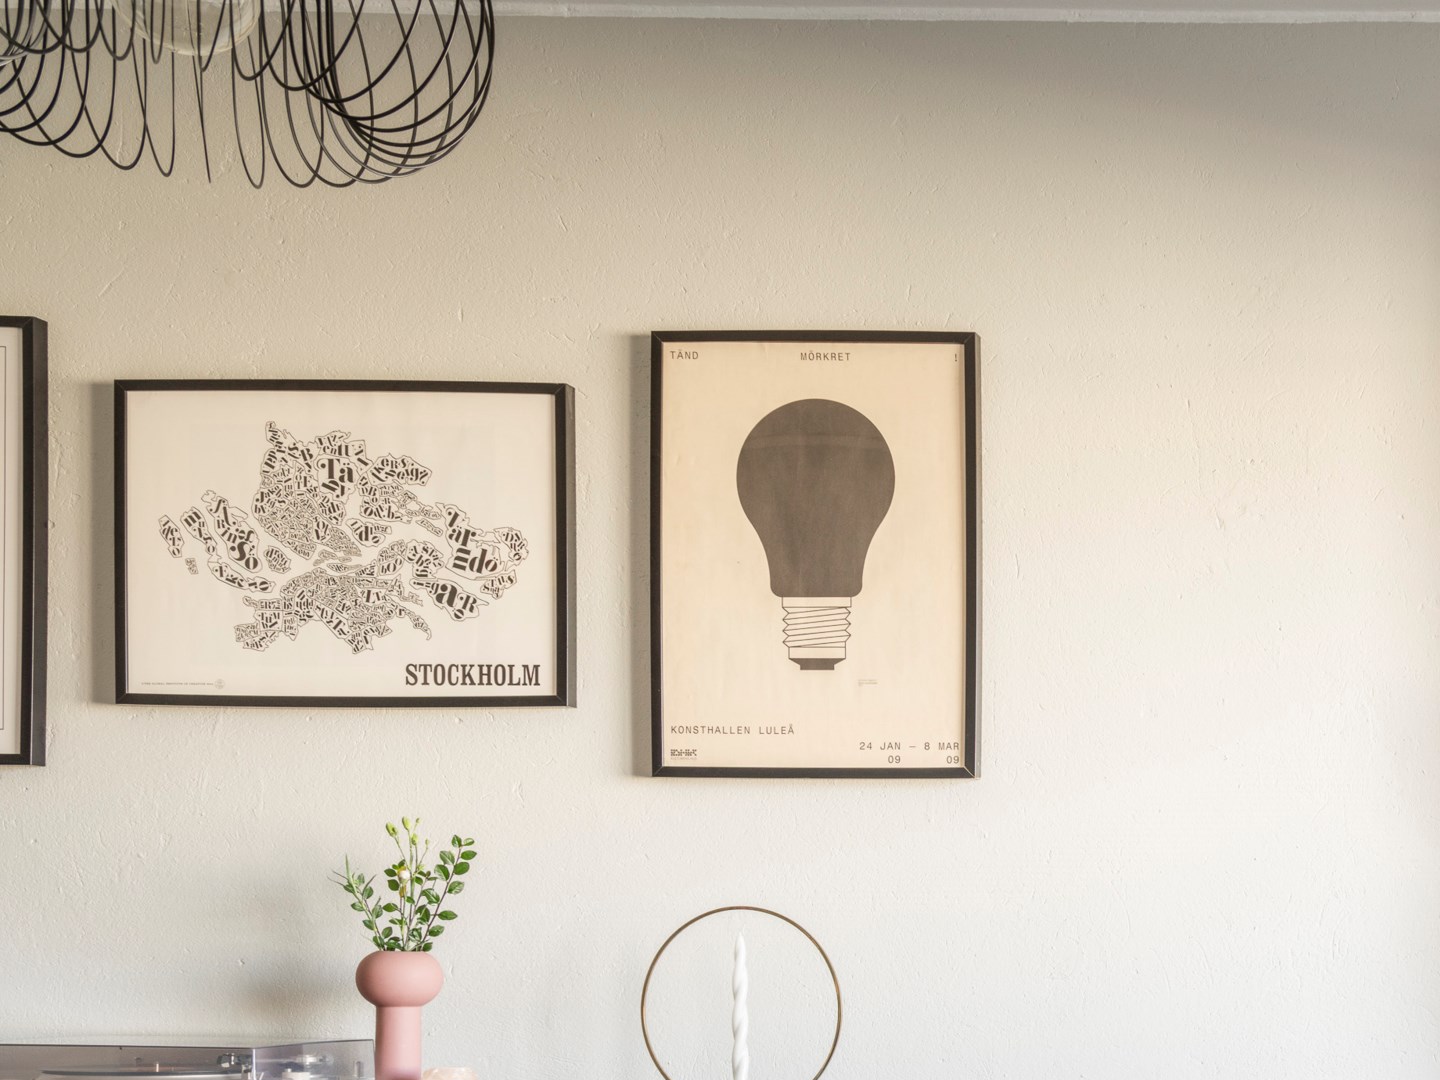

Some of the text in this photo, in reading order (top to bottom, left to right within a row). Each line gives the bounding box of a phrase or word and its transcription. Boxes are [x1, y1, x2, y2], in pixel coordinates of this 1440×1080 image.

[670, 349, 699, 360] TÄND
[800, 350, 851, 362] MÖRKRET
[406, 664, 540, 686] STOCKHOLM
[670, 724, 794, 735] KONSTHALLEN LULEÅ
[859, 742, 873, 751] 24
[880, 742, 902, 751] JAN
[924, 742, 930, 751] 8
[938, 742, 960, 751] MAR
[888, 754, 902, 764] 09
[946, 754, 960, 764] 09
